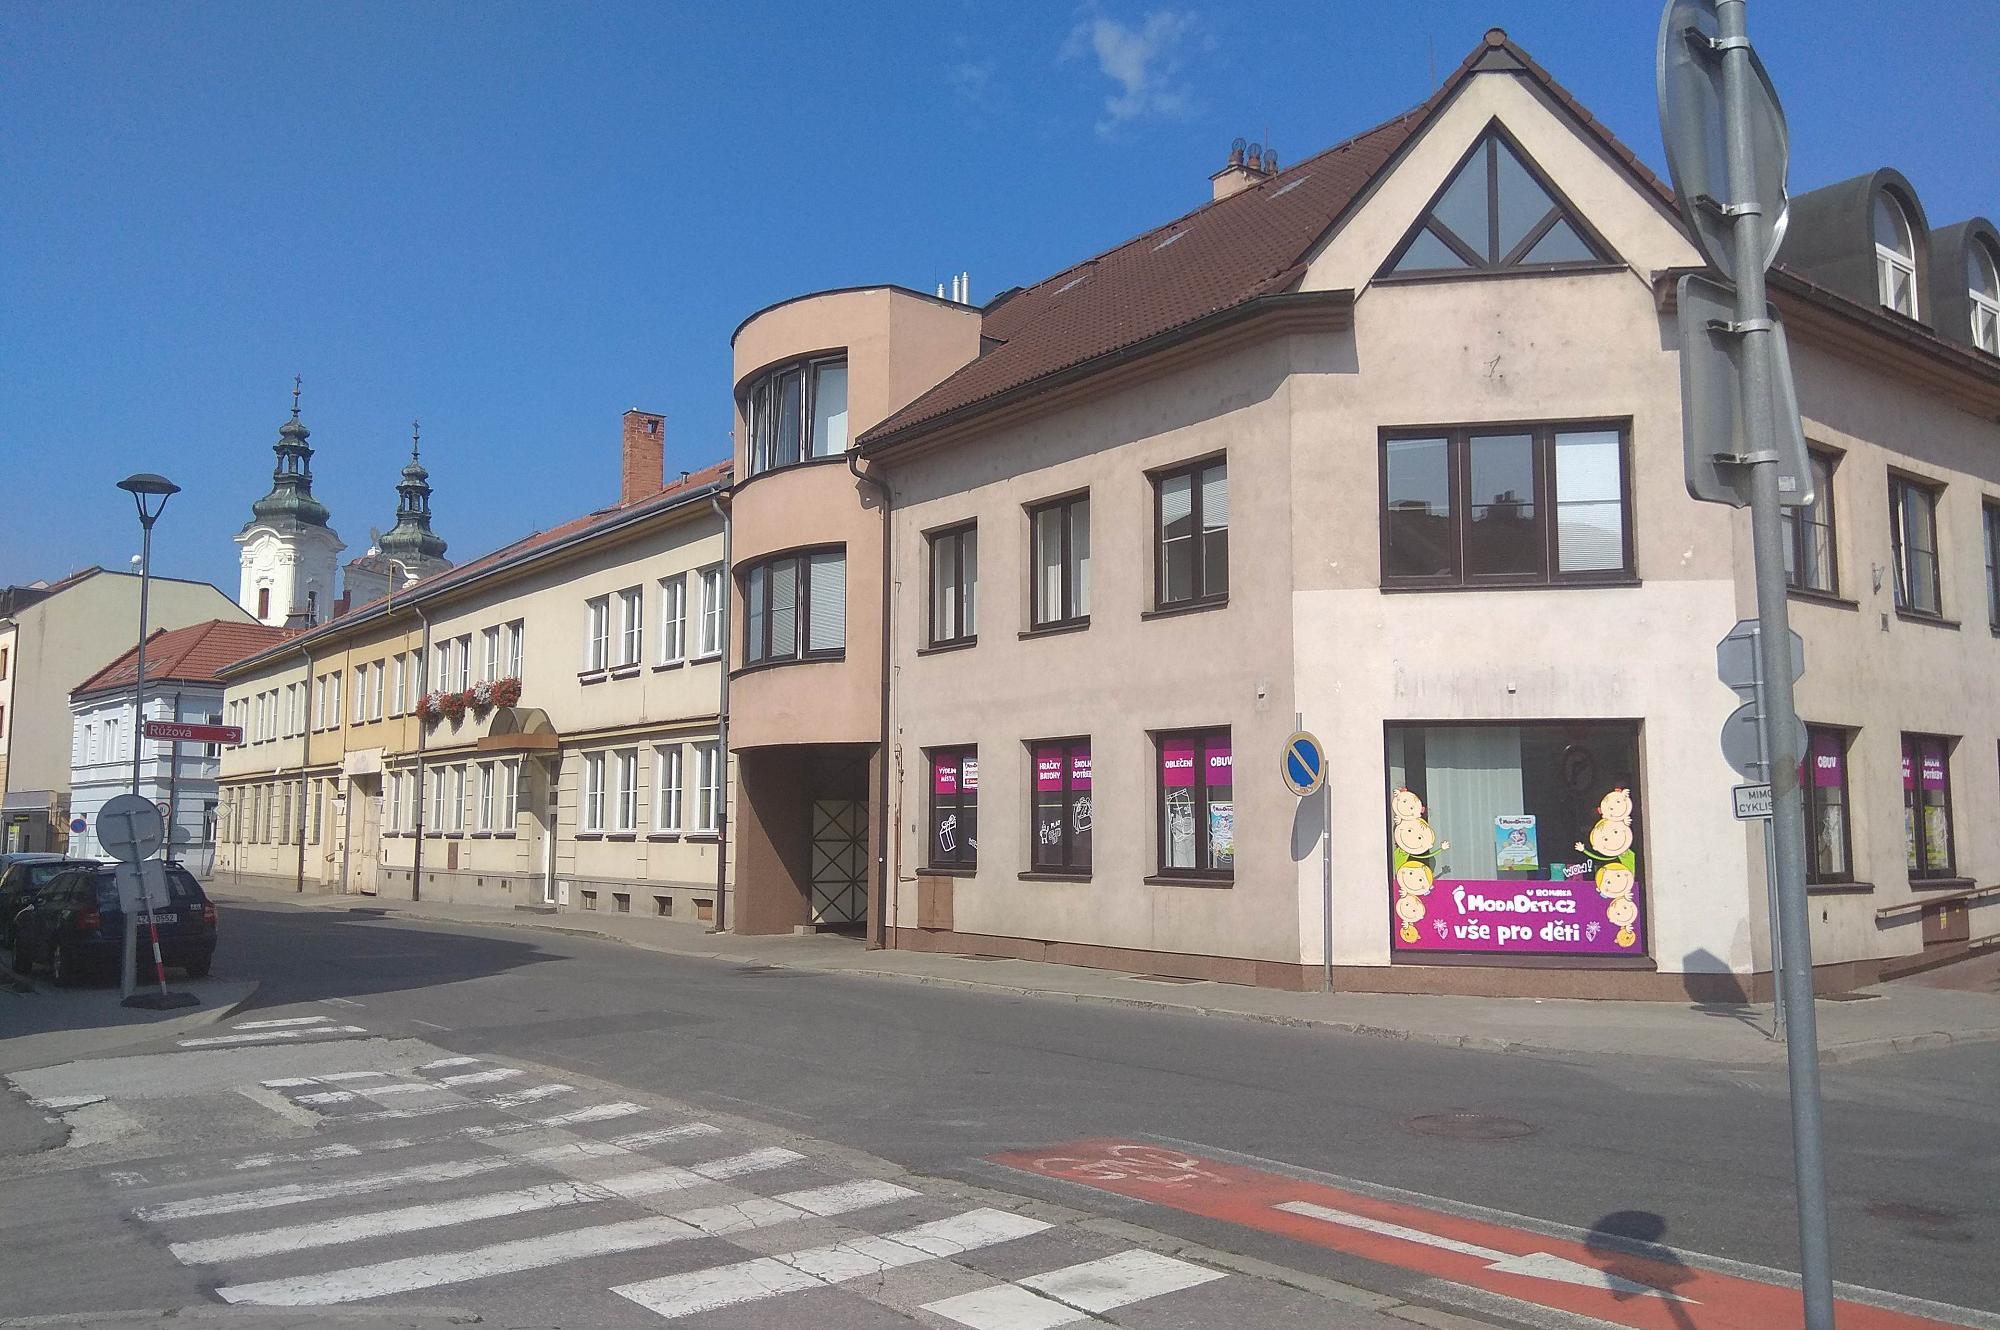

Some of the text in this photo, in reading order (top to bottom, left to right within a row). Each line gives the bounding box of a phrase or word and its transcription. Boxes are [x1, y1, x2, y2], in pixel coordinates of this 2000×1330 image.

[150, 725, 192, 737] Růžová
[1040, 760, 1060, 770] HRAČKY
[1165, 757, 1193, 769] OBLEČENÍ
[1211, 756, 1233, 767] OBUV
[1817, 755, 1836, 768] OBUV
[1040, 771, 1060, 780] BATOHY
[1563, 859, 1593, 878] WOW!
[1453, 919, 1580, 945] vše pro děti
